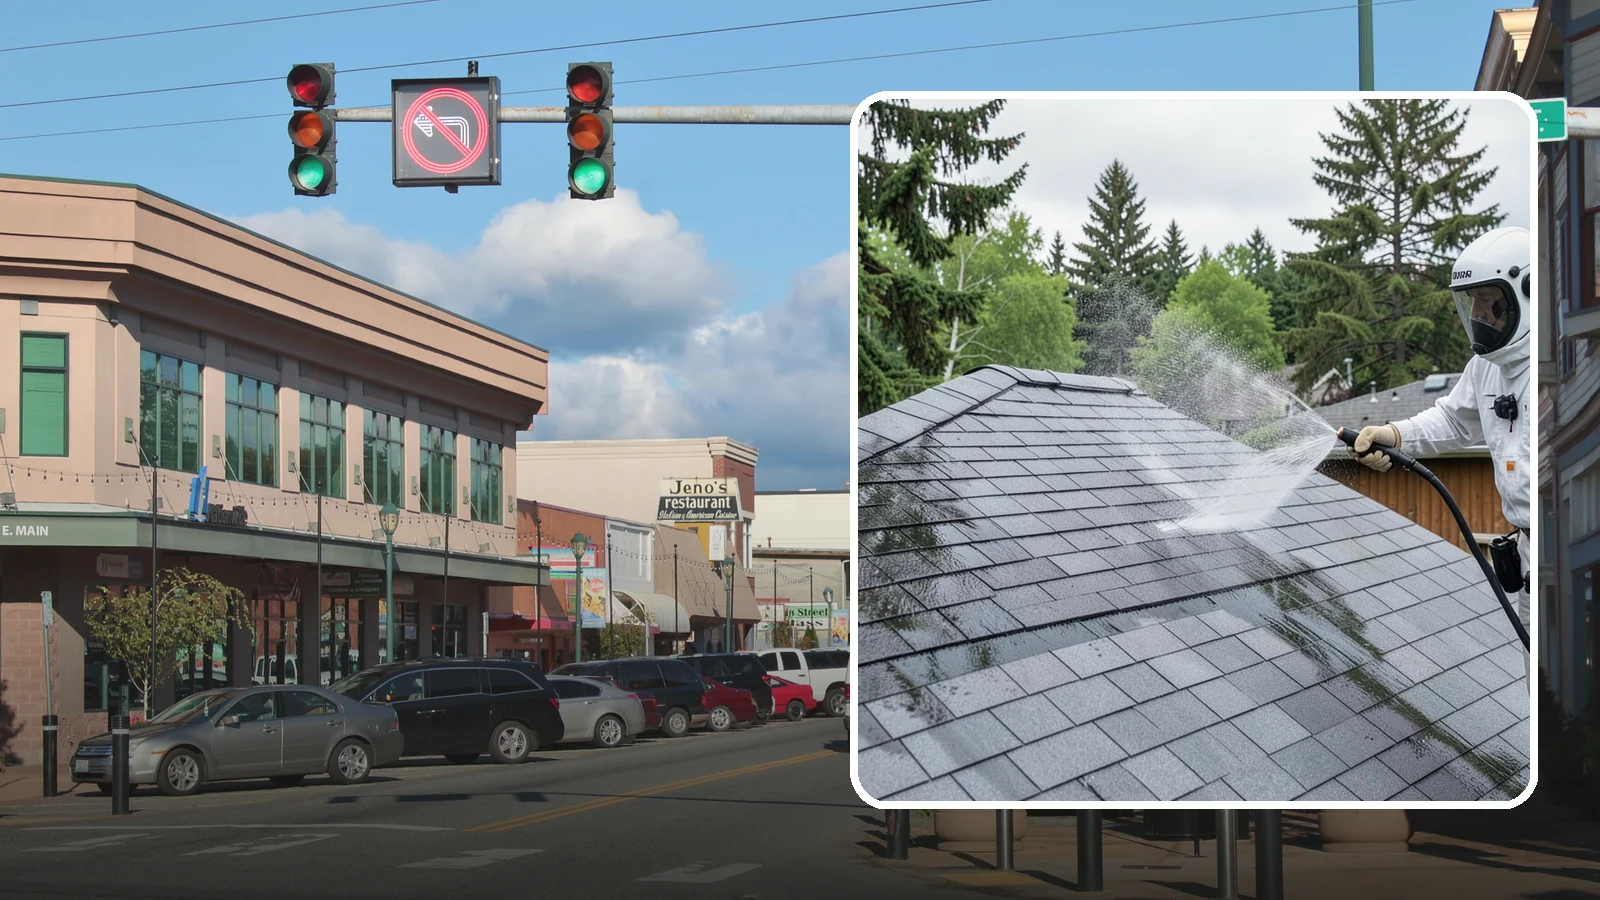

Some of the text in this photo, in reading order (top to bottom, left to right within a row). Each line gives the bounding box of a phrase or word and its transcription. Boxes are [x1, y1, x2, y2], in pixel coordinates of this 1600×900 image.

[670, 480, 728, 494] Jeno's
[664, 496, 731, 508] restaurant
[658, 510, 682, 519] Italian
[686, 510, 714, 519] American
[715, 510, 738, 519] Cuisine
[2, 525, 49, 536] E. MAIN
[798, 608, 828, 616] Street
